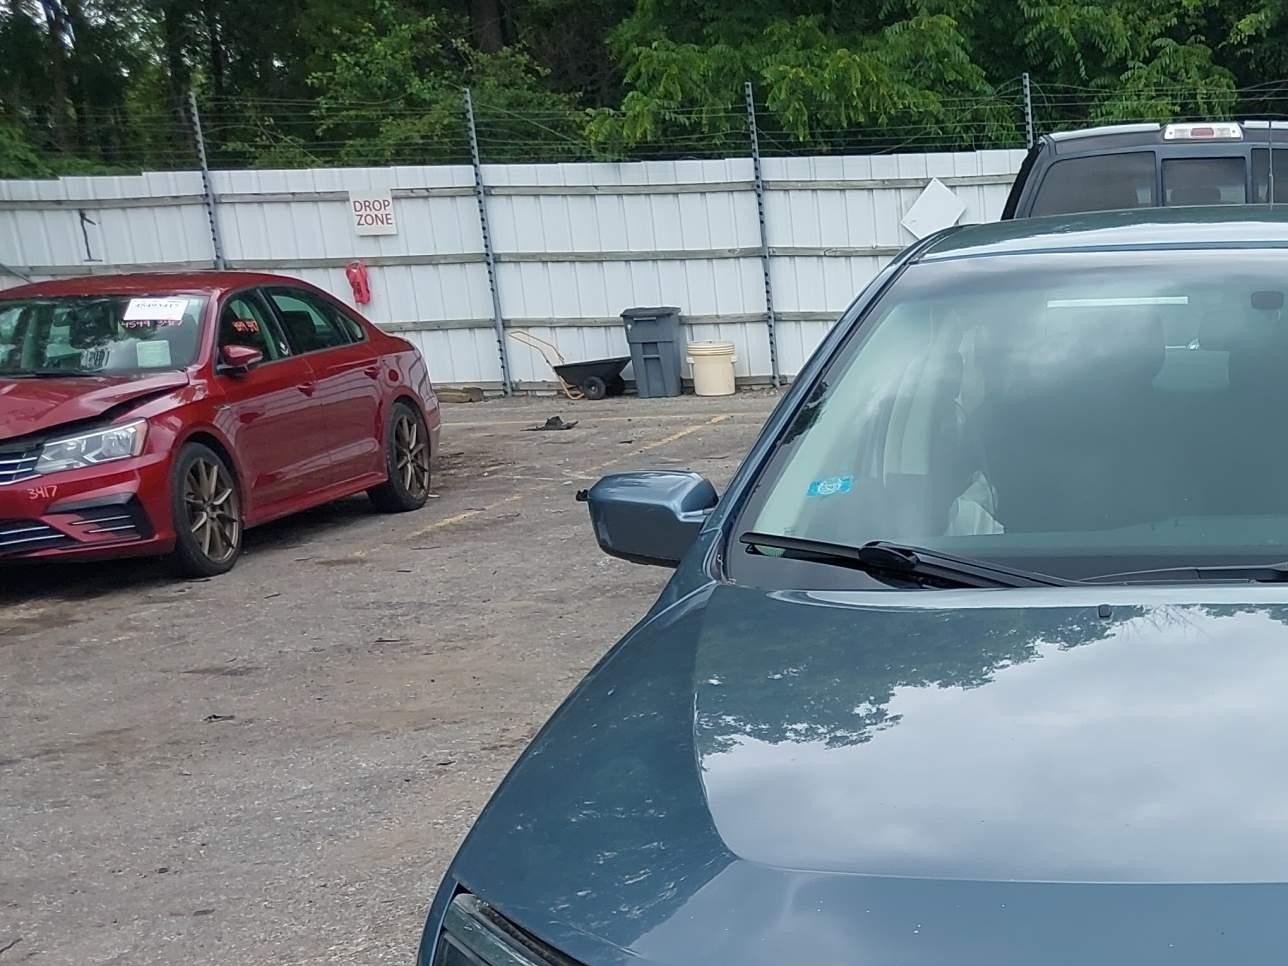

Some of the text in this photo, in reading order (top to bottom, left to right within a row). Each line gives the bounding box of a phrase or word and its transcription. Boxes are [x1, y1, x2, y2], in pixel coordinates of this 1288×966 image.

[353, 199, 391, 213] DROP
[355, 213, 393, 226] ZONE
[26, 485, 58, 500] 3417
